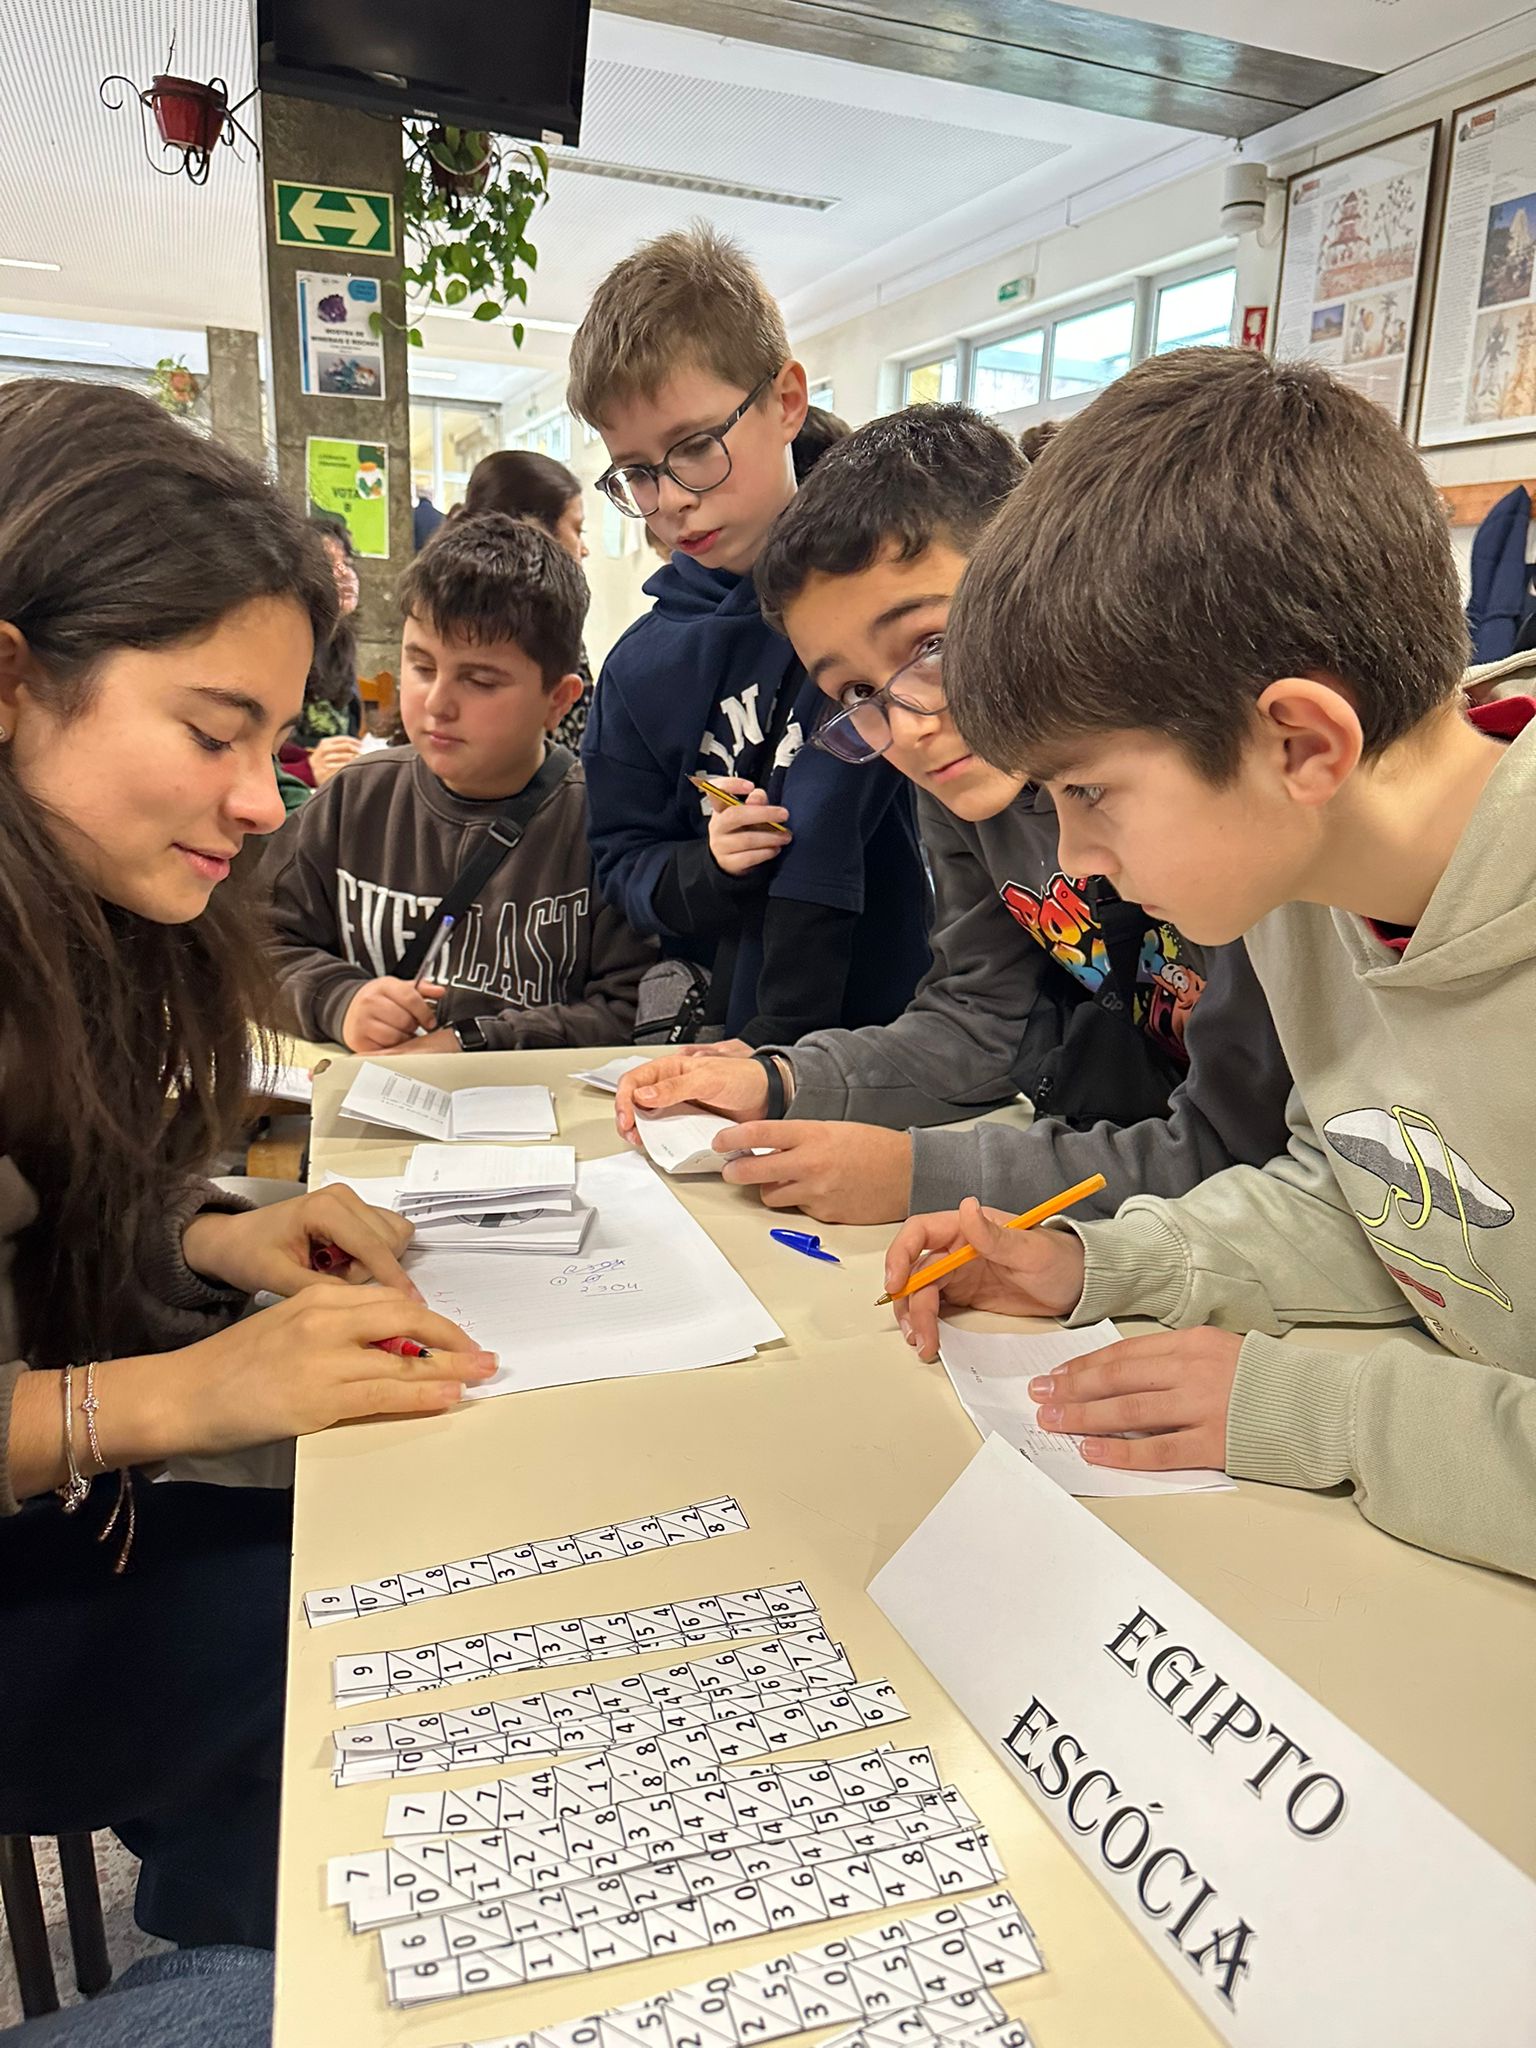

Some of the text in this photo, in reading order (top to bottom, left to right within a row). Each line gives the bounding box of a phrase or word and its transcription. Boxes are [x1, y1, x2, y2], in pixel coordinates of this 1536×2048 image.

[668, 1512, 698, 1541] 7 2
[708, 1503, 737, 1532] 8 1
[585, 1532, 616, 1560] 5 4
[627, 1523, 658, 1550] 6 3
[498, 1550, 532, 1578] 3 6
[542, 1543, 575, 1569] 4 5
[360, 1579, 398, 1605] 0 9
[407, 1569, 443, 1597] 1 8
[453, 1577, 470, 1588] 2
[682, 1600, 717, 1626] 6 3
[726, 1592, 760, 1619] 7 2
[771, 1586, 803, 1611] 8 1
[590, 1617, 626, 1644] 4 5
[636, 1608, 671, 1636] 5 4
[493, 1632, 533, 1662] 2 7
[542, 1623, 579, 1653] 3 6
[793, 1632, 825, 1666] 7 2
[353, 1666, 373, 1675] 9
[394, 1649, 436, 1679] 0 9
[444, 1639, 484, 1672] 1 8
[747, 1644, 779, 1675] 6 4
[652, 1666, 688, 1696] 4 8
[700, 1655, 735, 1687] 5 6
[808, 1676, 828, 1684] 7
[553, 1688, 592, 1717] 3 2
[603, 1678, 640, 1707] 4 0
[864, 1685, 896, 1720] 6 3
[449, 1707, 491, 1737] 1 6
[502, 1697, 542, 1727] 2 4
[769, 1708, 804, 1743] 4 9
[817, 1696, 849, 1732] 5 6
[1103, 1605, 1347, 1841] EGIPTO
[395, 1717, 439, 1745] 0 8
[616, 1723, 635, 1733] 4
[720, 1718, 757, 1756] 4 2
[403, 1752, 423, 1762] 0
[637, 1743, 656, 1755] 8
[670, 1731, 707, 1769] 3 5
[909, 1753, 929, 1765] 3
[588, 1780, 608, 1791] 1
[792, 1770, 830, 1809] 5 6
[844, 1758, 882, 1796] 6 3
[404, 1806, 425, 1817] 7
[446, 1791, 497, 1826] 0 7
[504, 1786, 553, 1822] 1 4
[684, 1788, 725, 1828] 4 2
[738, 1780, 779, 1818] 4 9
[572, 1810, 615, 1853] 2 8
[629, 1800, 672, 1839] 3 5
[816, 1812, 838, 1824] 5
[514, 1823, 560, 1865] 2 1
[855, 1834, 875, 1845] 4
[1001, 1694, 1257, 2014] ESCÓCIA
[394, 1847, 445, 1886] 0 7
[455, 1835, 502, 1876] 1 4
[596, 1853, 618, 1867] 2
[940, 1837, 975, 1884] 5 4
[347, 1870, 369, 1882] 7
[634, 1863, 676, 1904] 2 4
[692, 1876, 715, 1889] 3
[830, 1861, 871, 1908] 4 2
[885, 1849, 924, 1896] 4 8
[417, 1889, 439, 1902] 0
[576, 1878, 620, 1919] 1 8
[713, 1885, 757, 1934] 3 0
[772, 1873, 814, 1921] 3 6
[453, 1907, 502, 1948] 0 6
[515, 1892, 562, 1933] 1 2
[936, 1909, 957, 1924] 0
[402, 1934, 427, 1948] 6
[592, 1943, 616, 1958] 1
[654, 1929, 677, 1946] 2
[984, 1922, 1023, 1974] 4 5
[925, 1939, 965, 1991] 4 0
[707, 1977, 730, 1993] 0
[804, 1970, 847, 2018] 3 0
[866, 1956, 908, 2007] 3 5
[701, 1998, 725, 2013] 0
[741, 1983, 788, 2034] 2 5
[899, 2013, 924, 2034] 2
